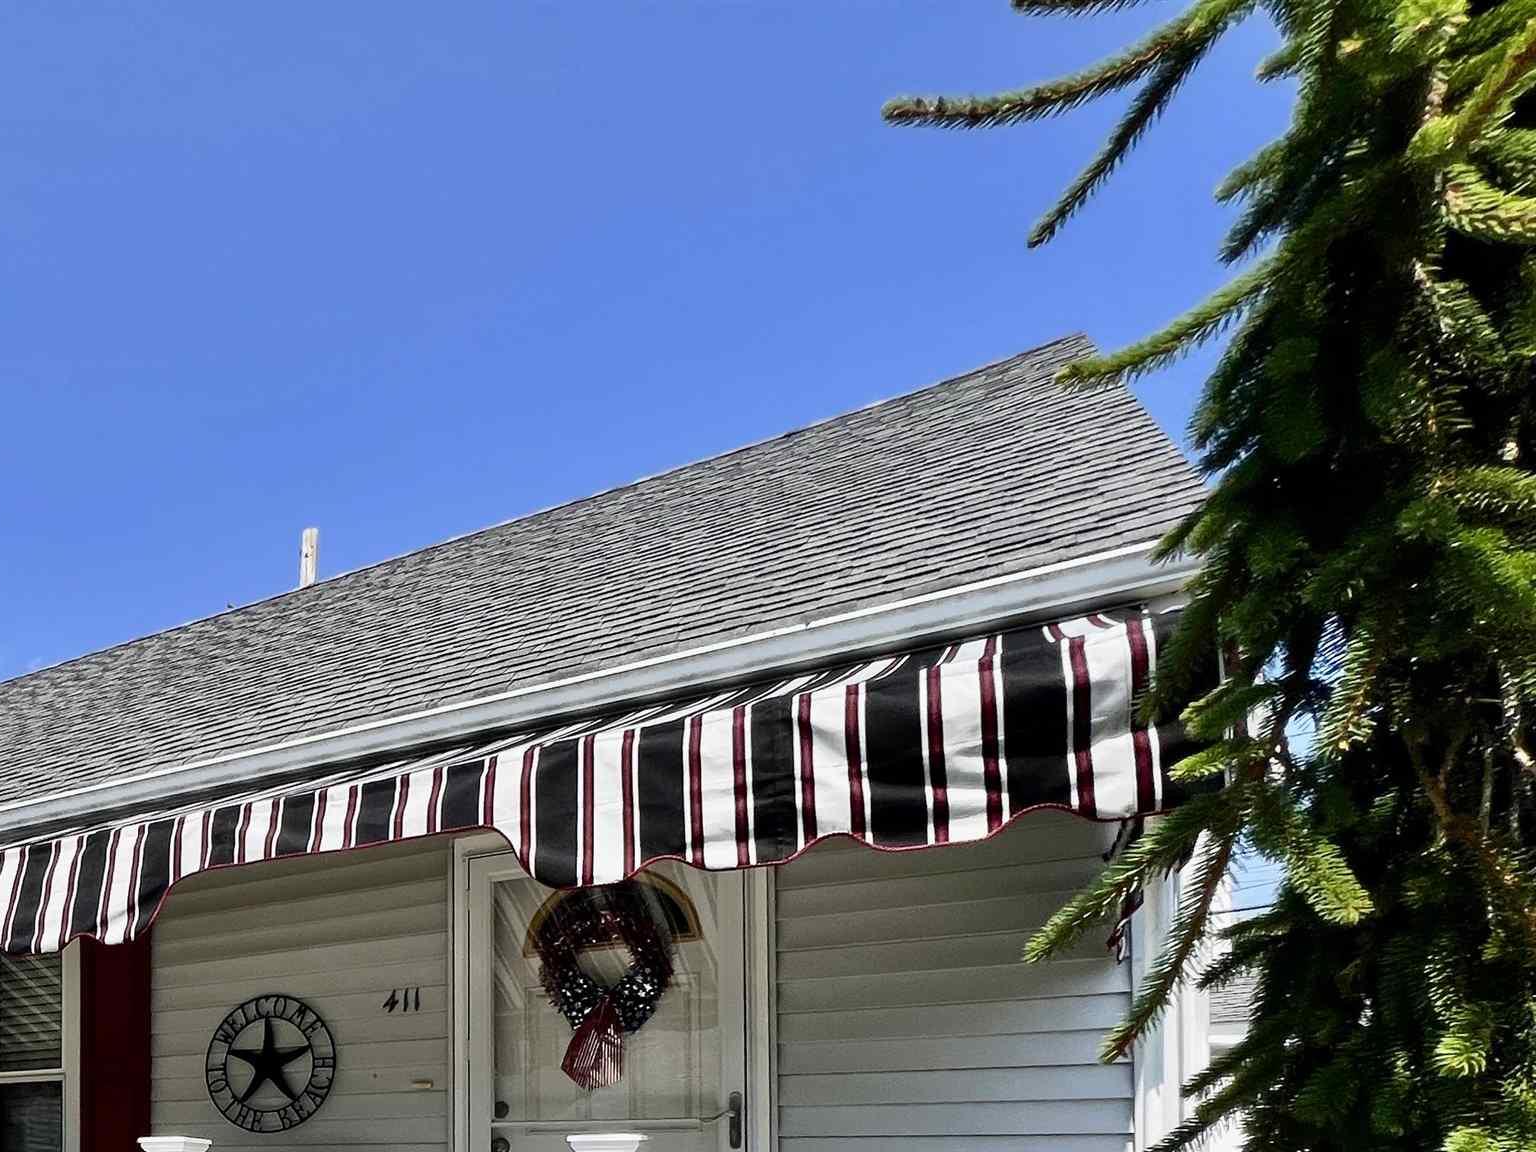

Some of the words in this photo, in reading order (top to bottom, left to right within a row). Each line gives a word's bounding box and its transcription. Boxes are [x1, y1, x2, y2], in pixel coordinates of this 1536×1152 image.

[214, 996, 324, 1045] WELCOME
[383, 987, 420, 1013] 411
[207, 1063, 230, 1093] TO
[224, 1098, 264, 1132] THE
[277, 1057, 335, 1130] BEACH
